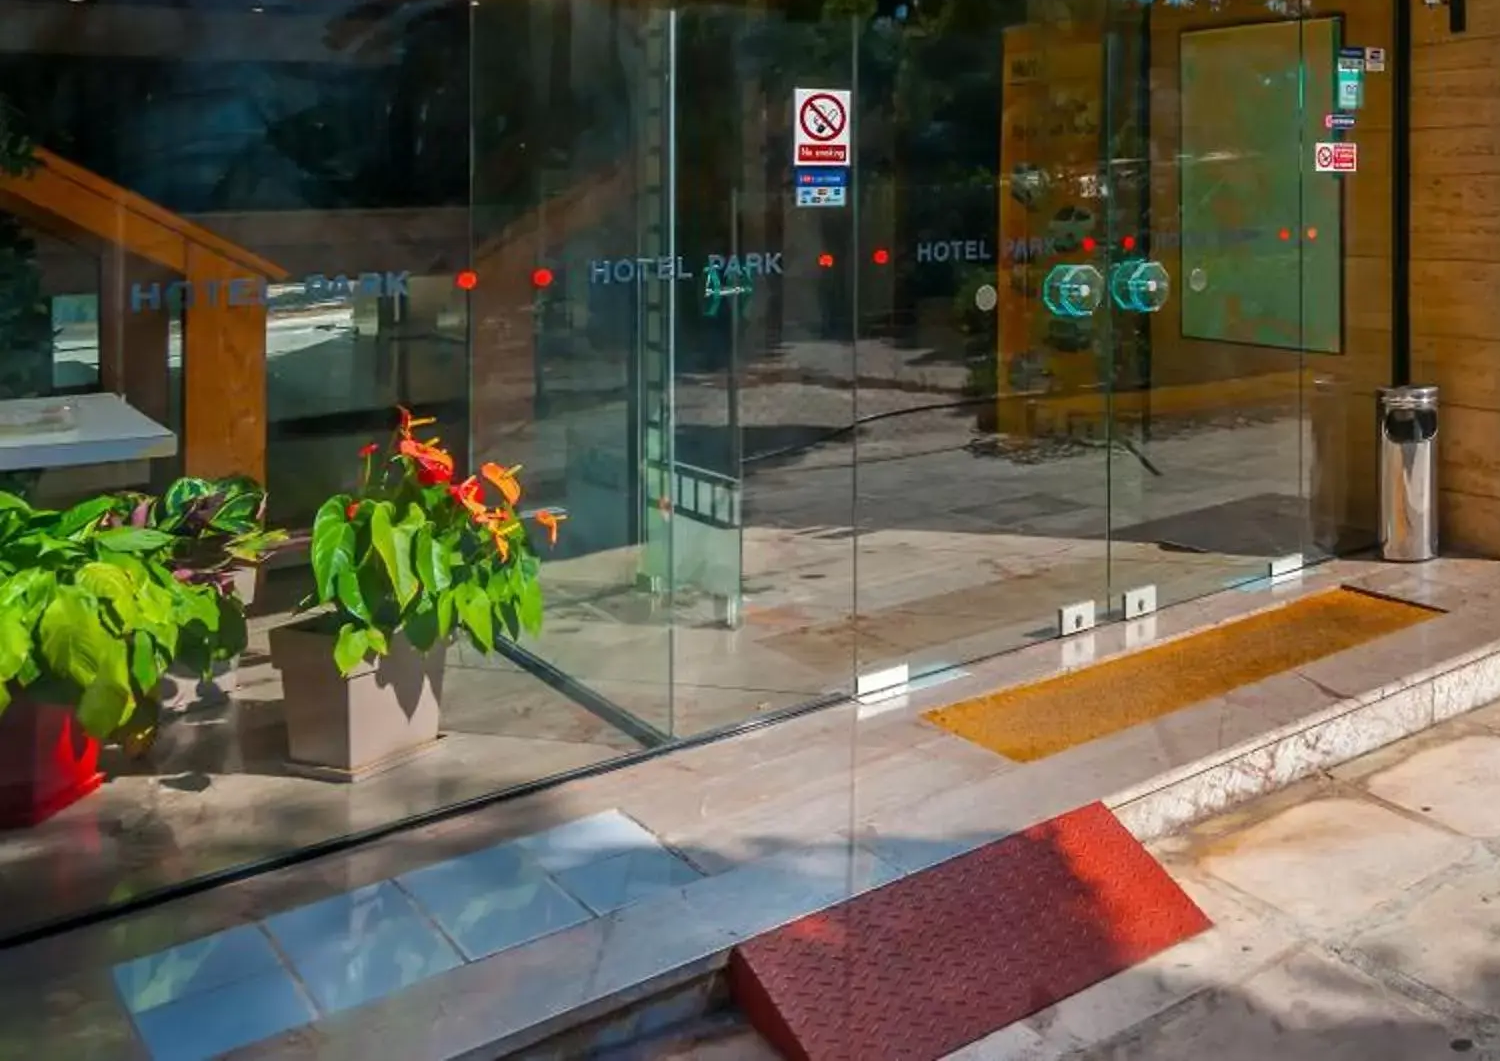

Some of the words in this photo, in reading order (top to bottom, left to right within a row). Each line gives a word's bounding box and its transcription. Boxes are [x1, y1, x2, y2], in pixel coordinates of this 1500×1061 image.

[802, 147, 813, 156] No
[816, 147, 844, 159] smoking
[917, 239, 991, 262] HOTEL
[1005, 237, 1057, 258] PARK
[591, 255, 693, 284] HOTEL
[707, 252, 783, 277] PARK
[131, 275, 282, 312] HOTEL
[305, 271, 409, 300] PARK
